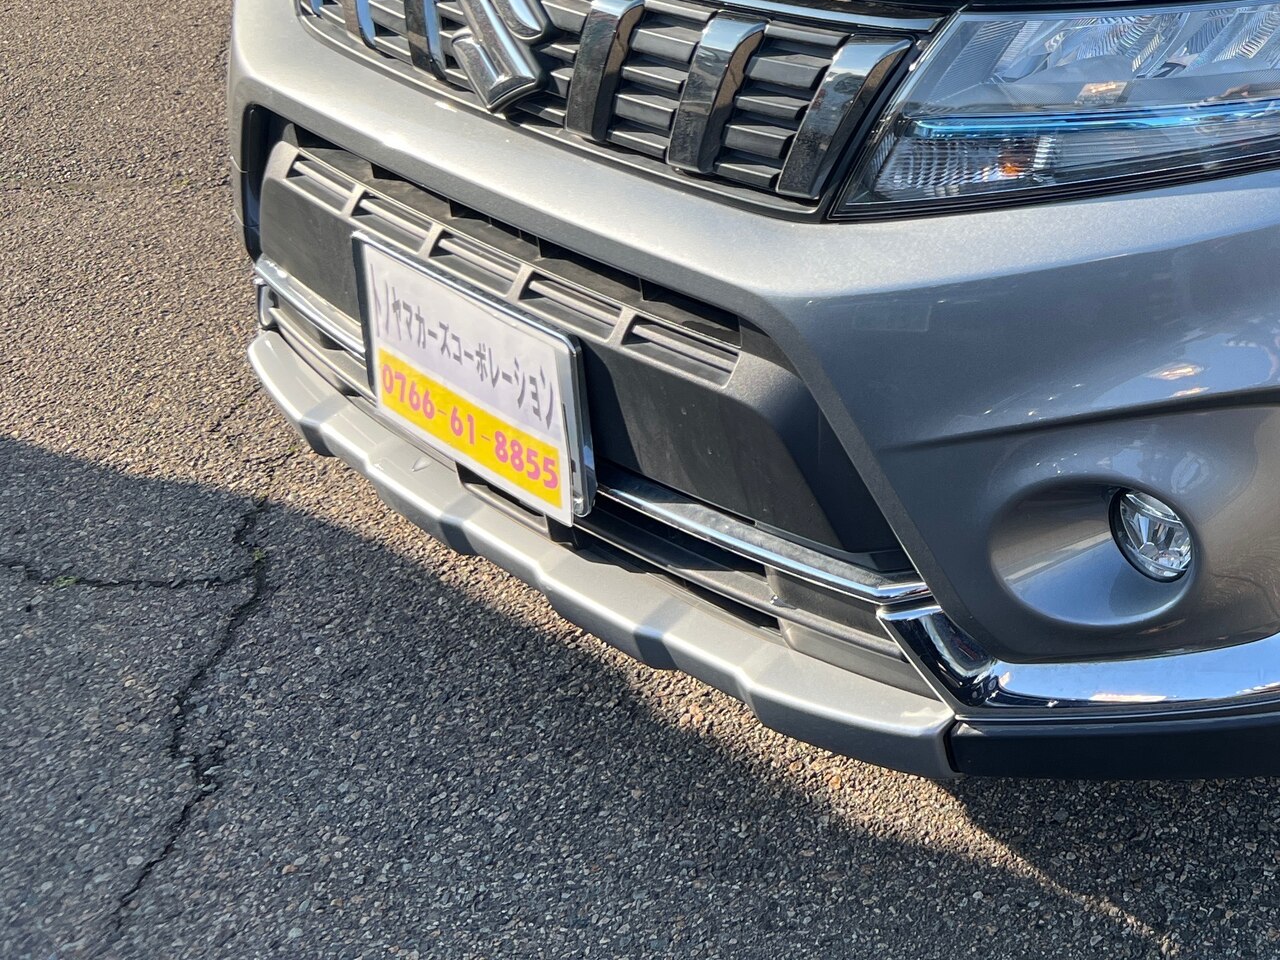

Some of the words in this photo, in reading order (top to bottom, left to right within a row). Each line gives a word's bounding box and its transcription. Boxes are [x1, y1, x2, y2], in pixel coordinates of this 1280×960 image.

[369, 263, 554, 430] トノヤマカーズコーポレーション
[381, 364, 559, 489] 0766-61-8855
